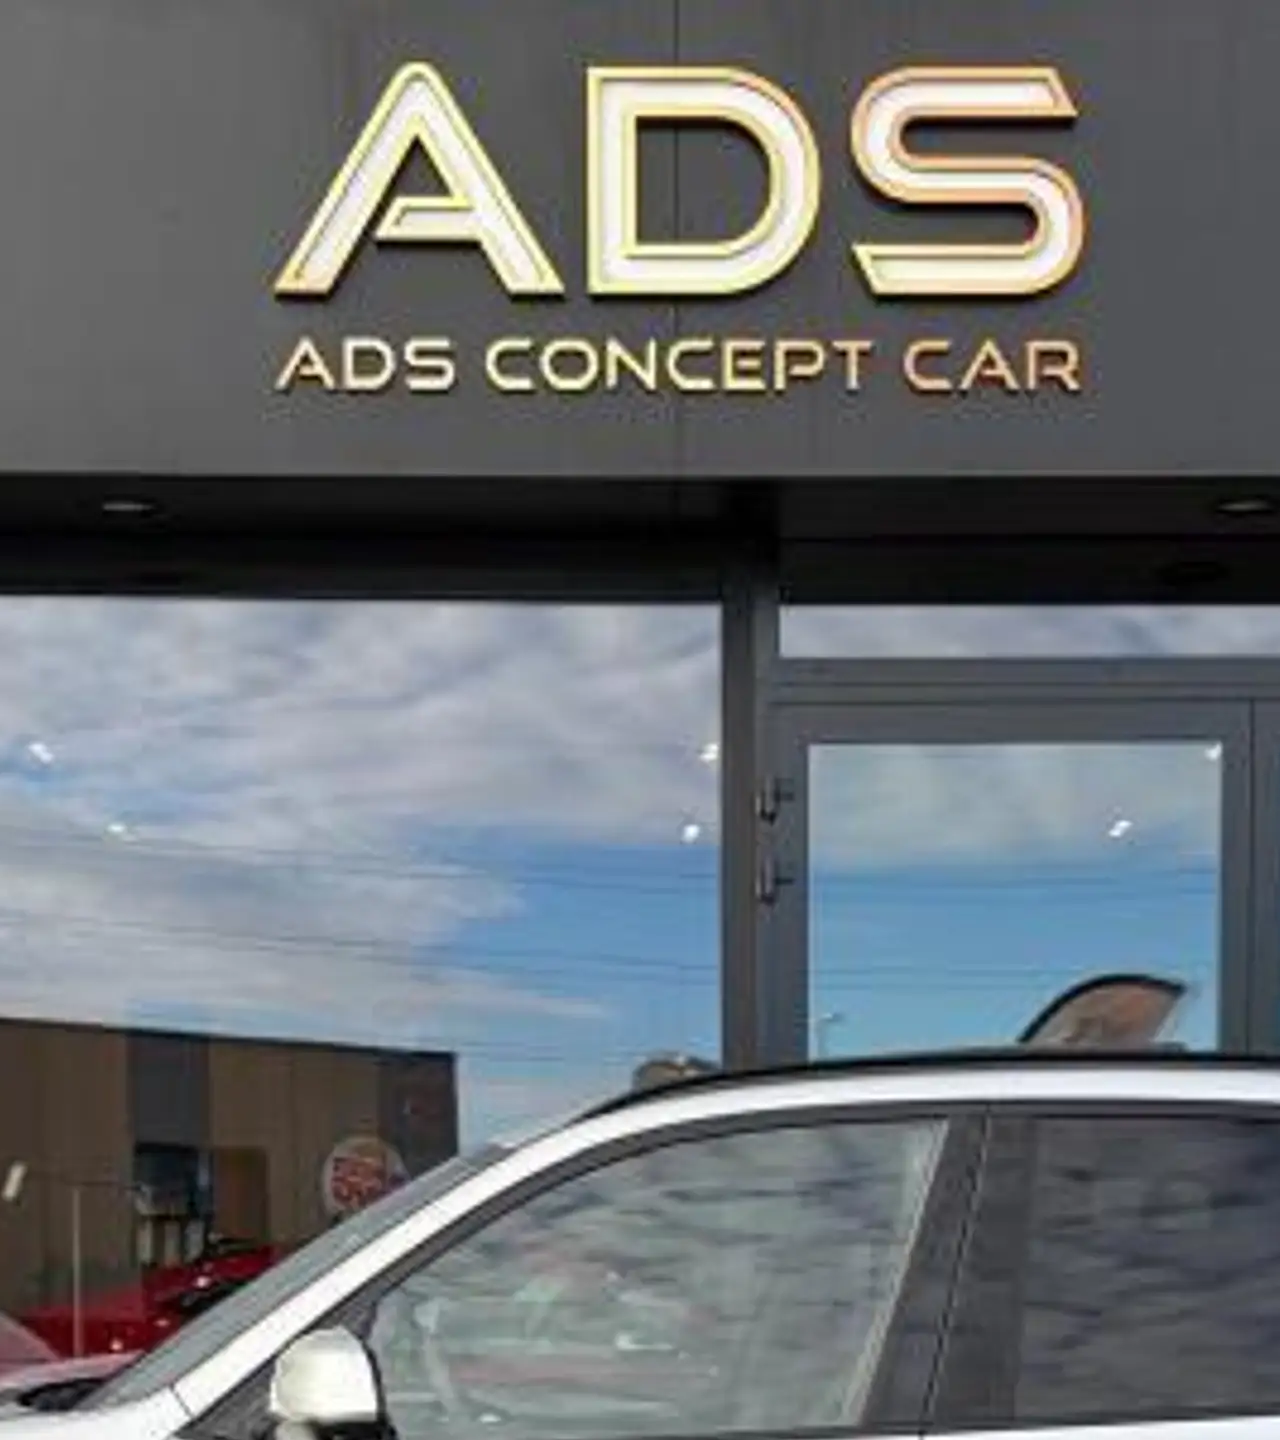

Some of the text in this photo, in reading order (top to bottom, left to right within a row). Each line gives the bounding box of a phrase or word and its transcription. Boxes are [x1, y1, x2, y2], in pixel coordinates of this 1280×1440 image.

[274, 61, 1084, 296] ADS
[276, 337, 1081, 393] ADS CONCEPT CAR
